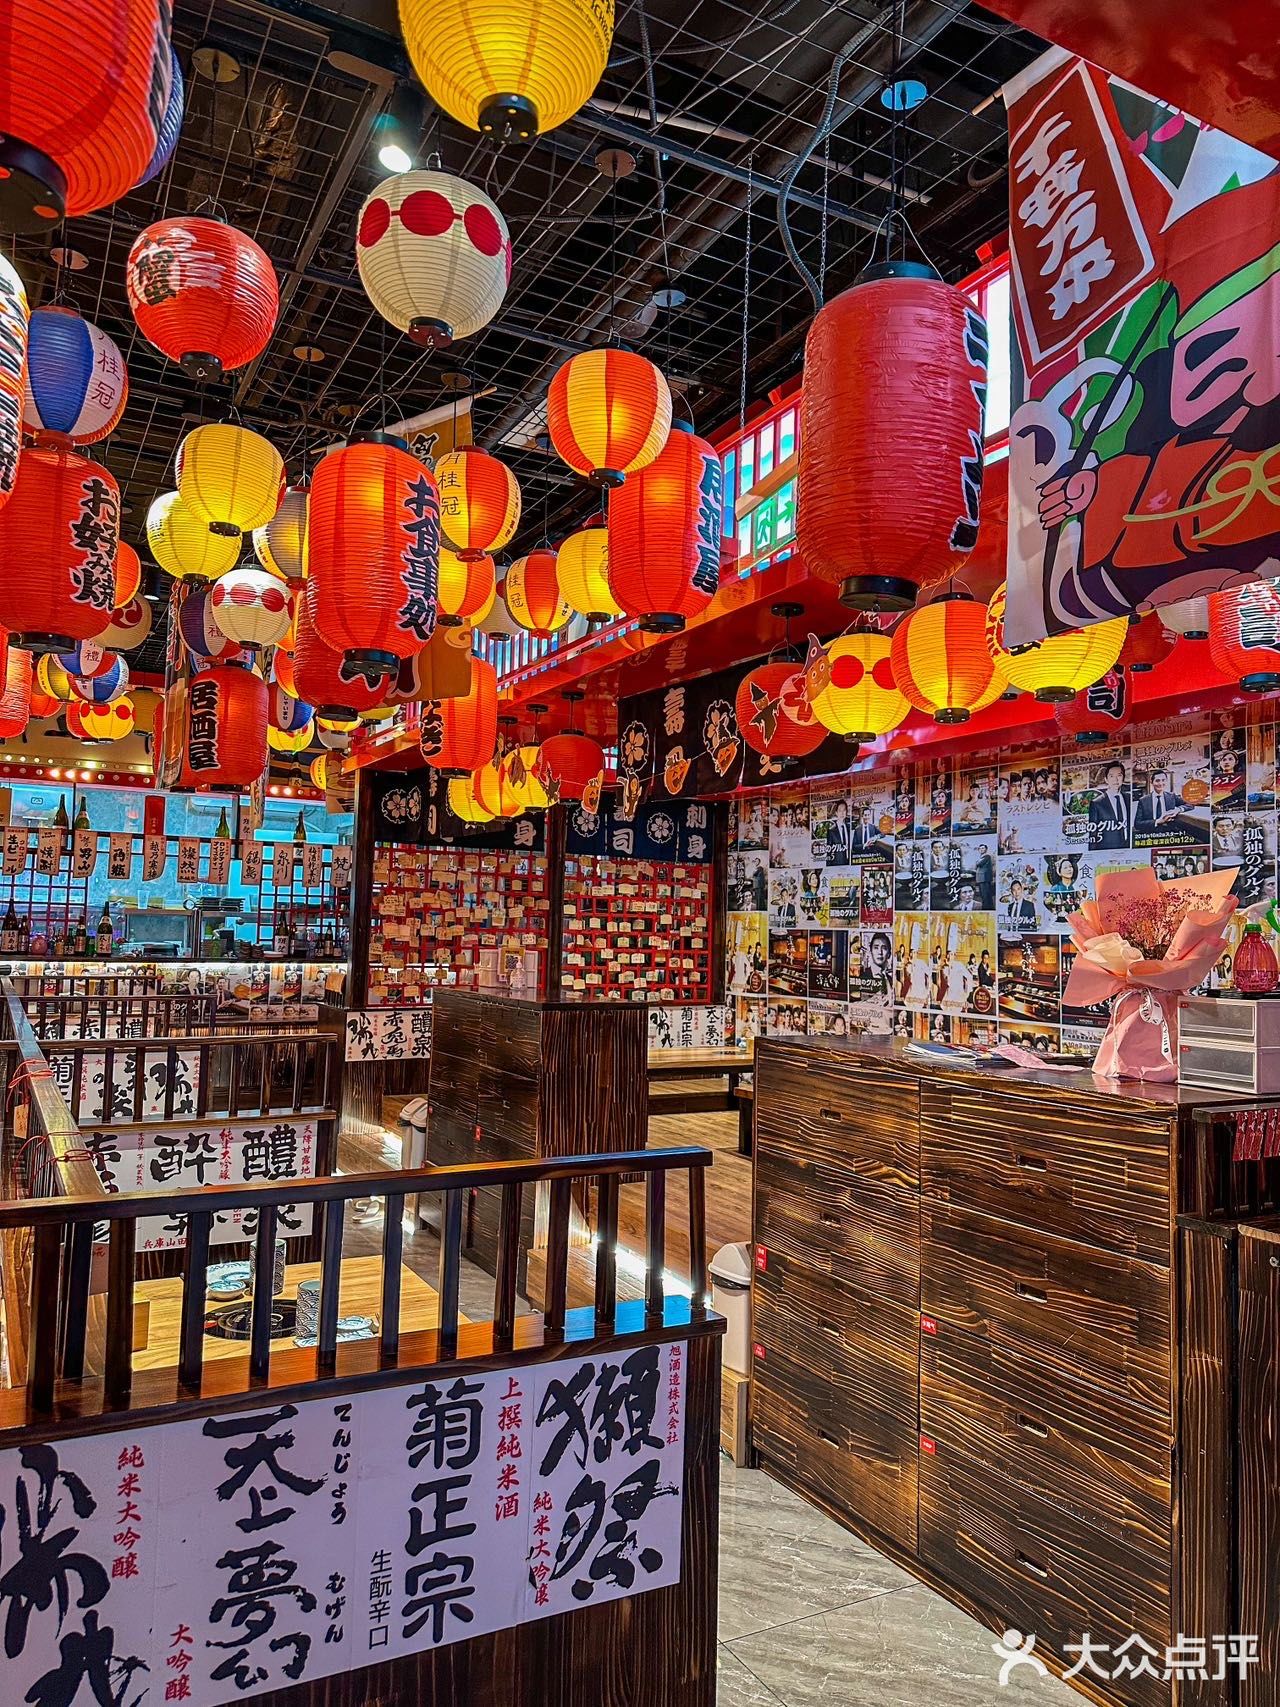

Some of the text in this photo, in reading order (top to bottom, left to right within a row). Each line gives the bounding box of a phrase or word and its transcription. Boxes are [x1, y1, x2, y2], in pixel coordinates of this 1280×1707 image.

[686, 803, 707, 860] 刺身
[1065, 819, 1128, 836] 孤独のグルメ
[1243, 827, 1265, 900] 孤独のグルメ
[681, 1006, 692, 1047] 菊正宗
[667, 1344, 683, 1446] 旭酒造株式会社
[495, 1376, 523, 1522] 上撰純米酒
[111, 1445, 145, 1580] 純米大吟醸
[202, 1404, 329, 1690] 天上夢幻
[324, 1404, 353, 1643] てんじょう むげん
[401, 1377, 485, 1644] 菊正宗
[164, 1622, 194, 1701] 大吟醸
